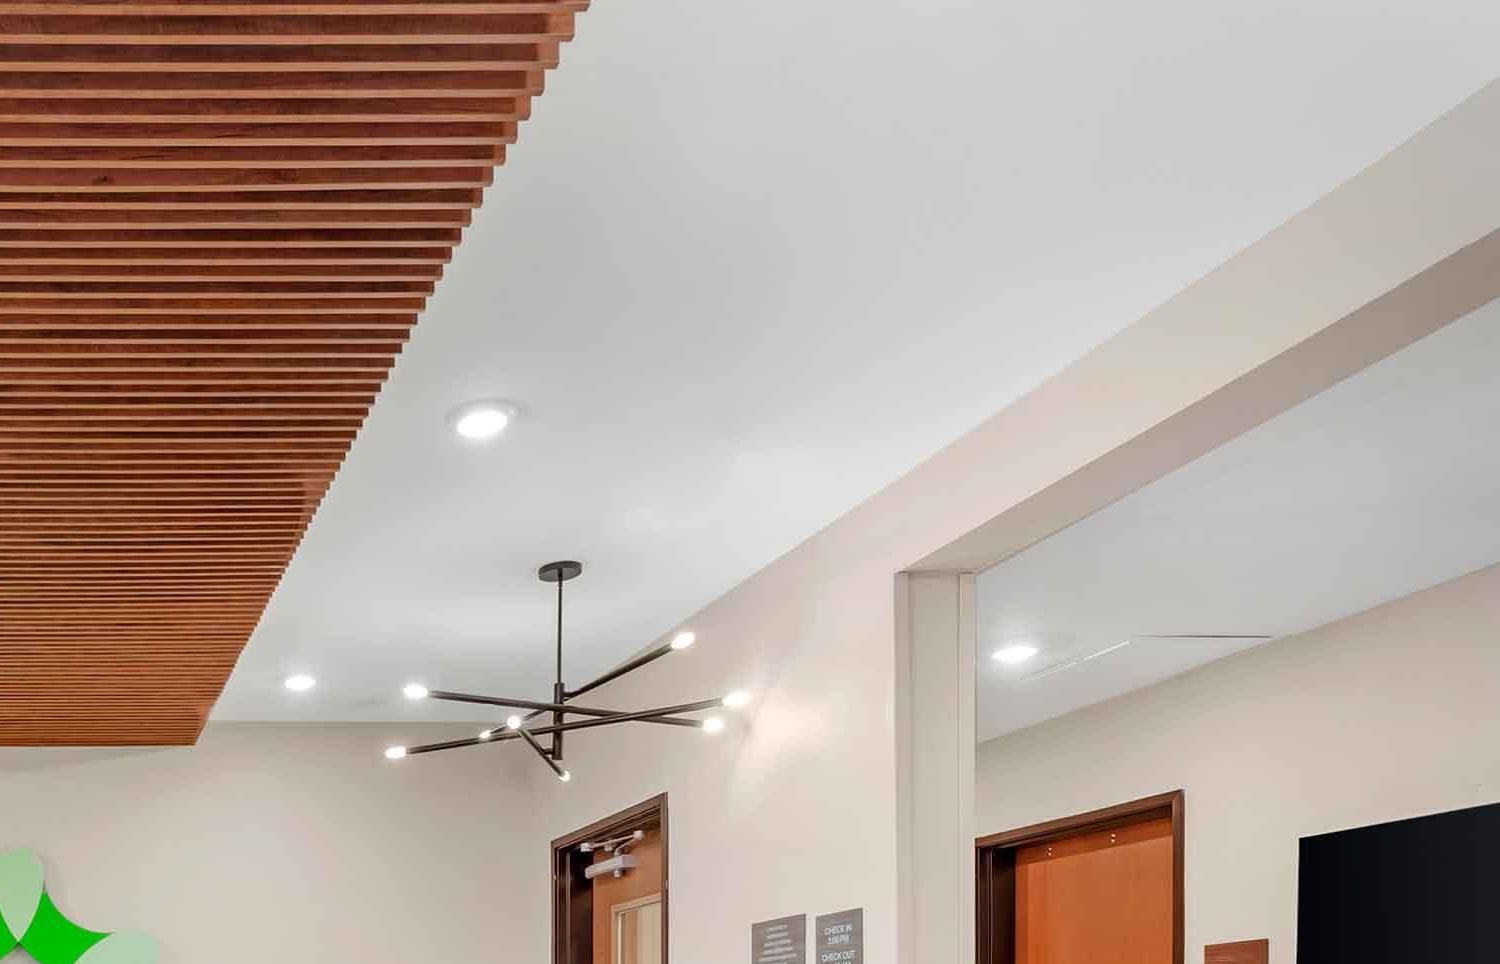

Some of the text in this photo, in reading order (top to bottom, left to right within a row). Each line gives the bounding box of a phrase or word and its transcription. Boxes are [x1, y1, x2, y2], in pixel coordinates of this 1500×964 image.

[824, 925, 845, 936] CHECK
[821, 949, 856, 962] CHECK OUT
